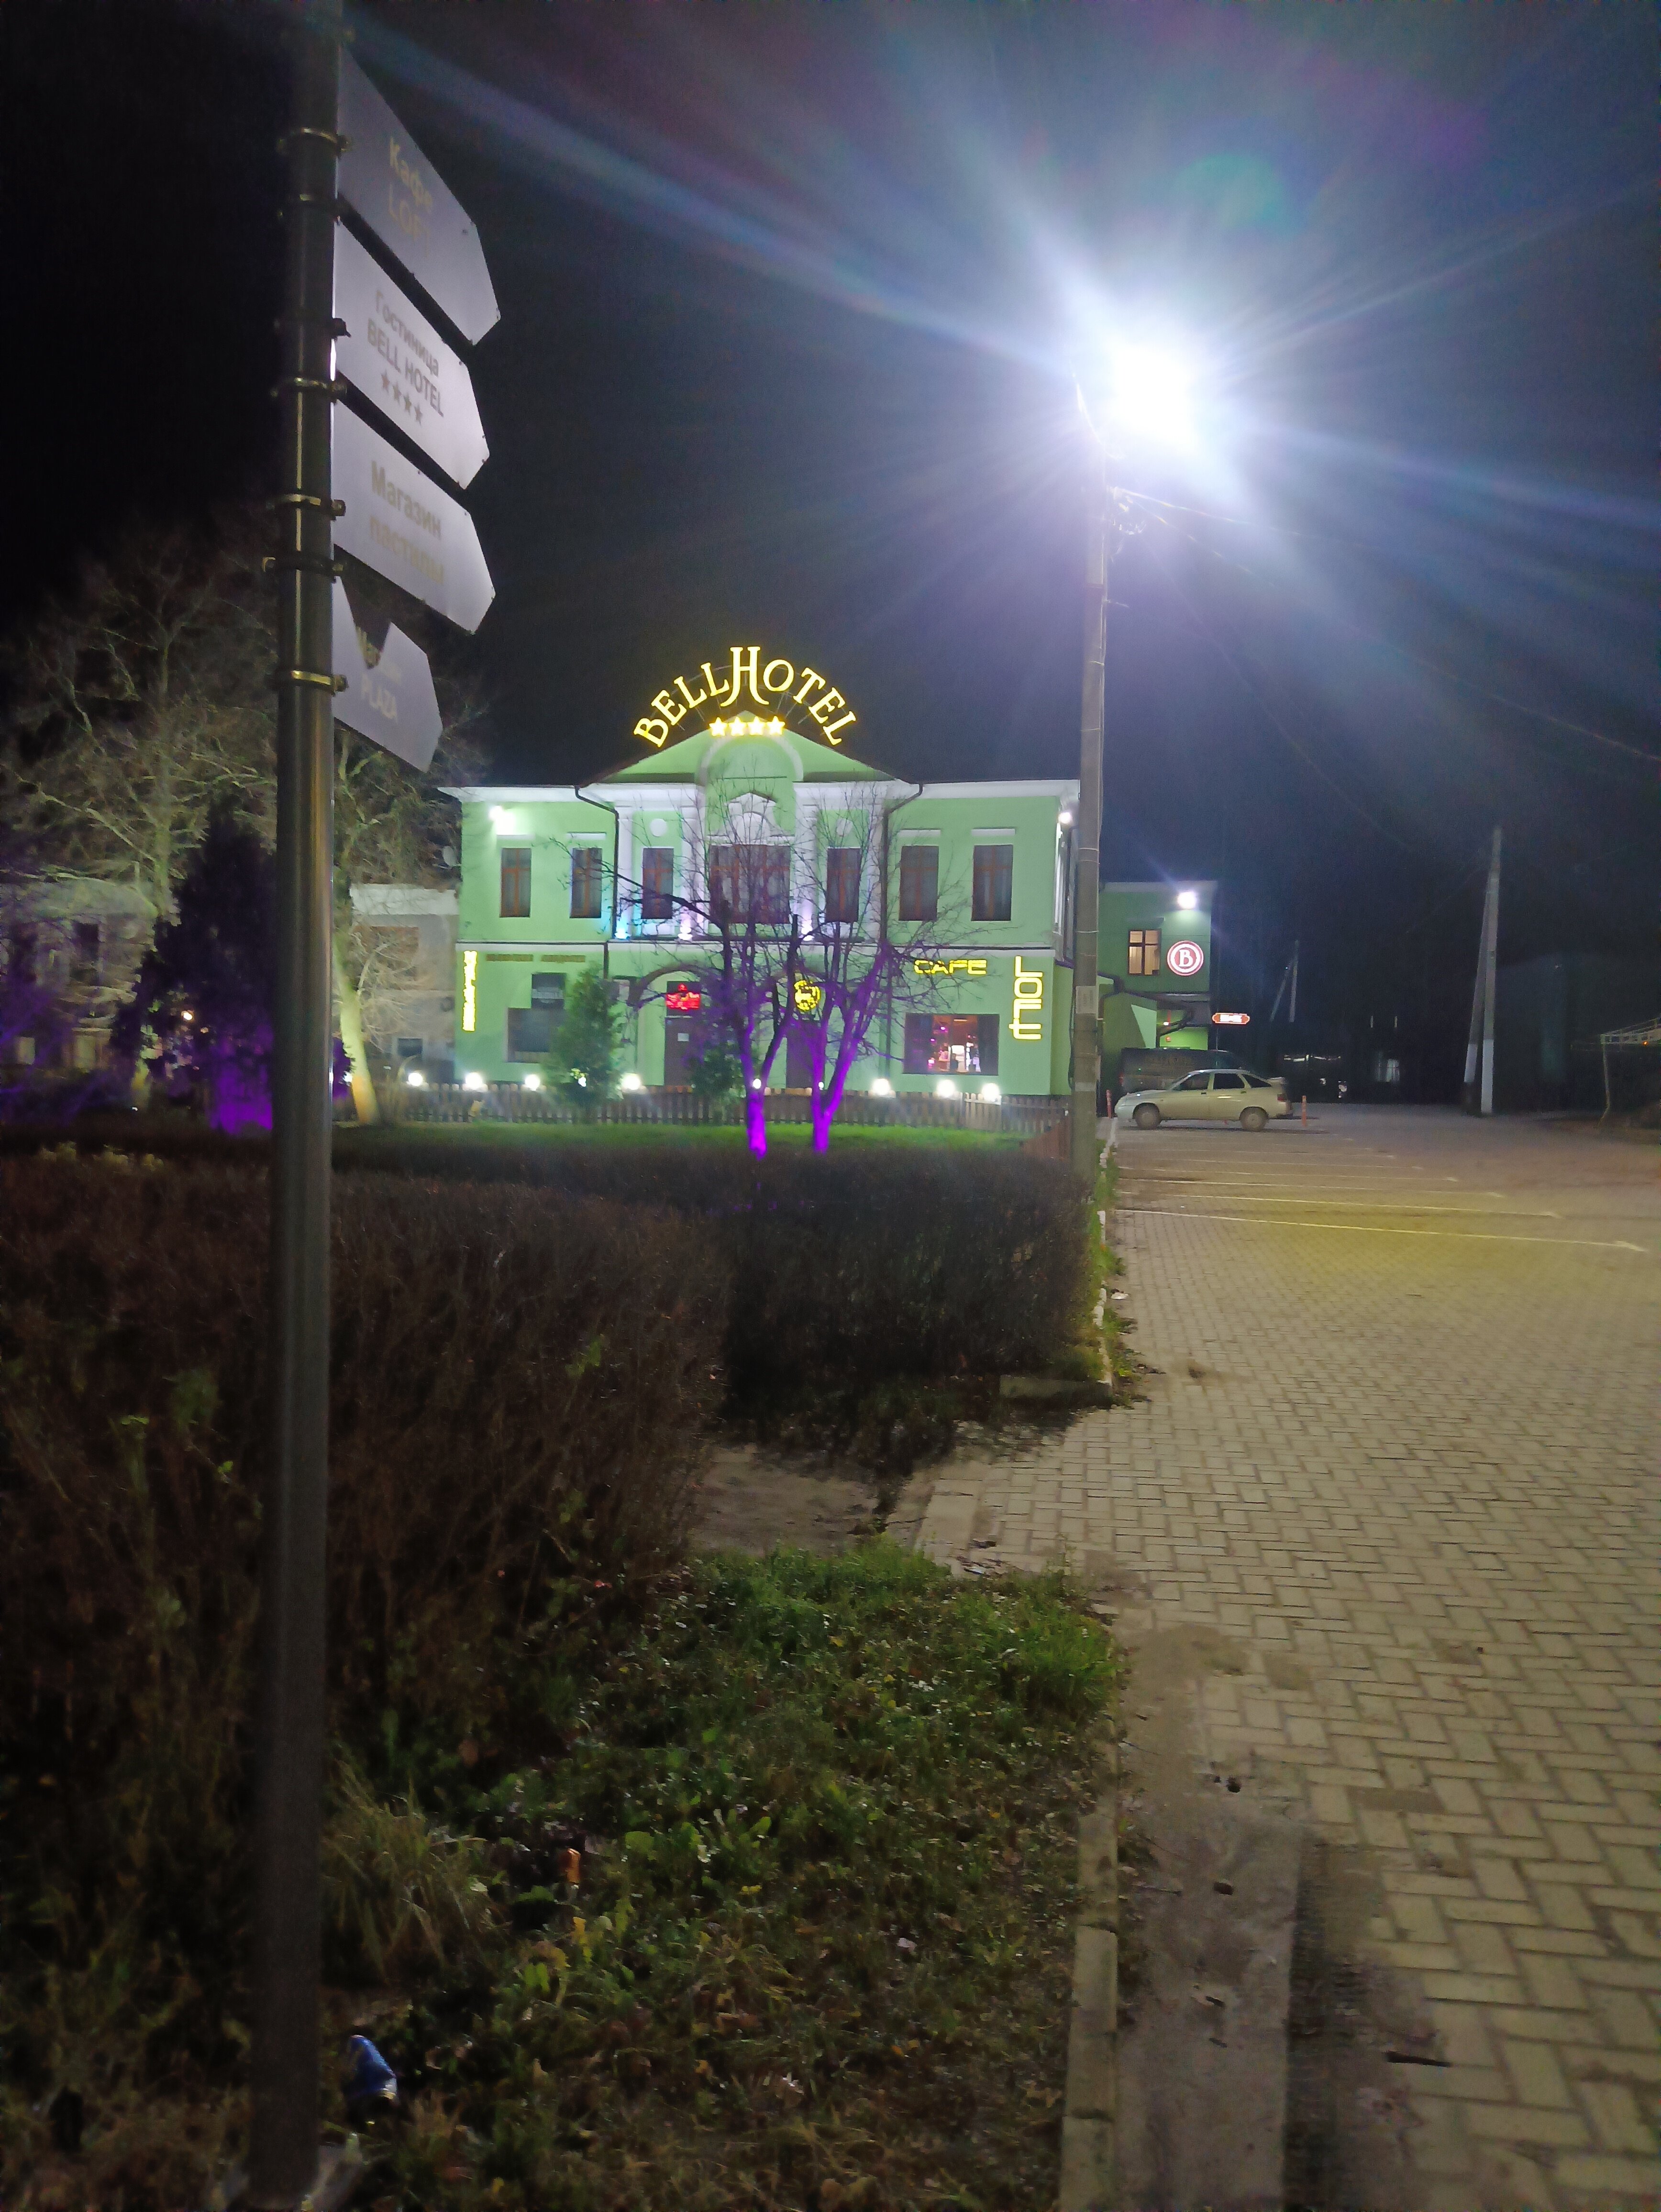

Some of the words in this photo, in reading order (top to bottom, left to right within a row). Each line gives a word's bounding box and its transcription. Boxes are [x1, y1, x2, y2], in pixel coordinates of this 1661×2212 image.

[367, 317, 401, 374] BELL
[404, 357, 444, 418] HOTEL
[375, 288, 440, 377] Гостиница
[371, 460, 442, 541] Магазин
[634, 663, 730, 747] BELL
[720, 646, 856, 745] HOTEL
[914, 960, 987, 974] CAFE
